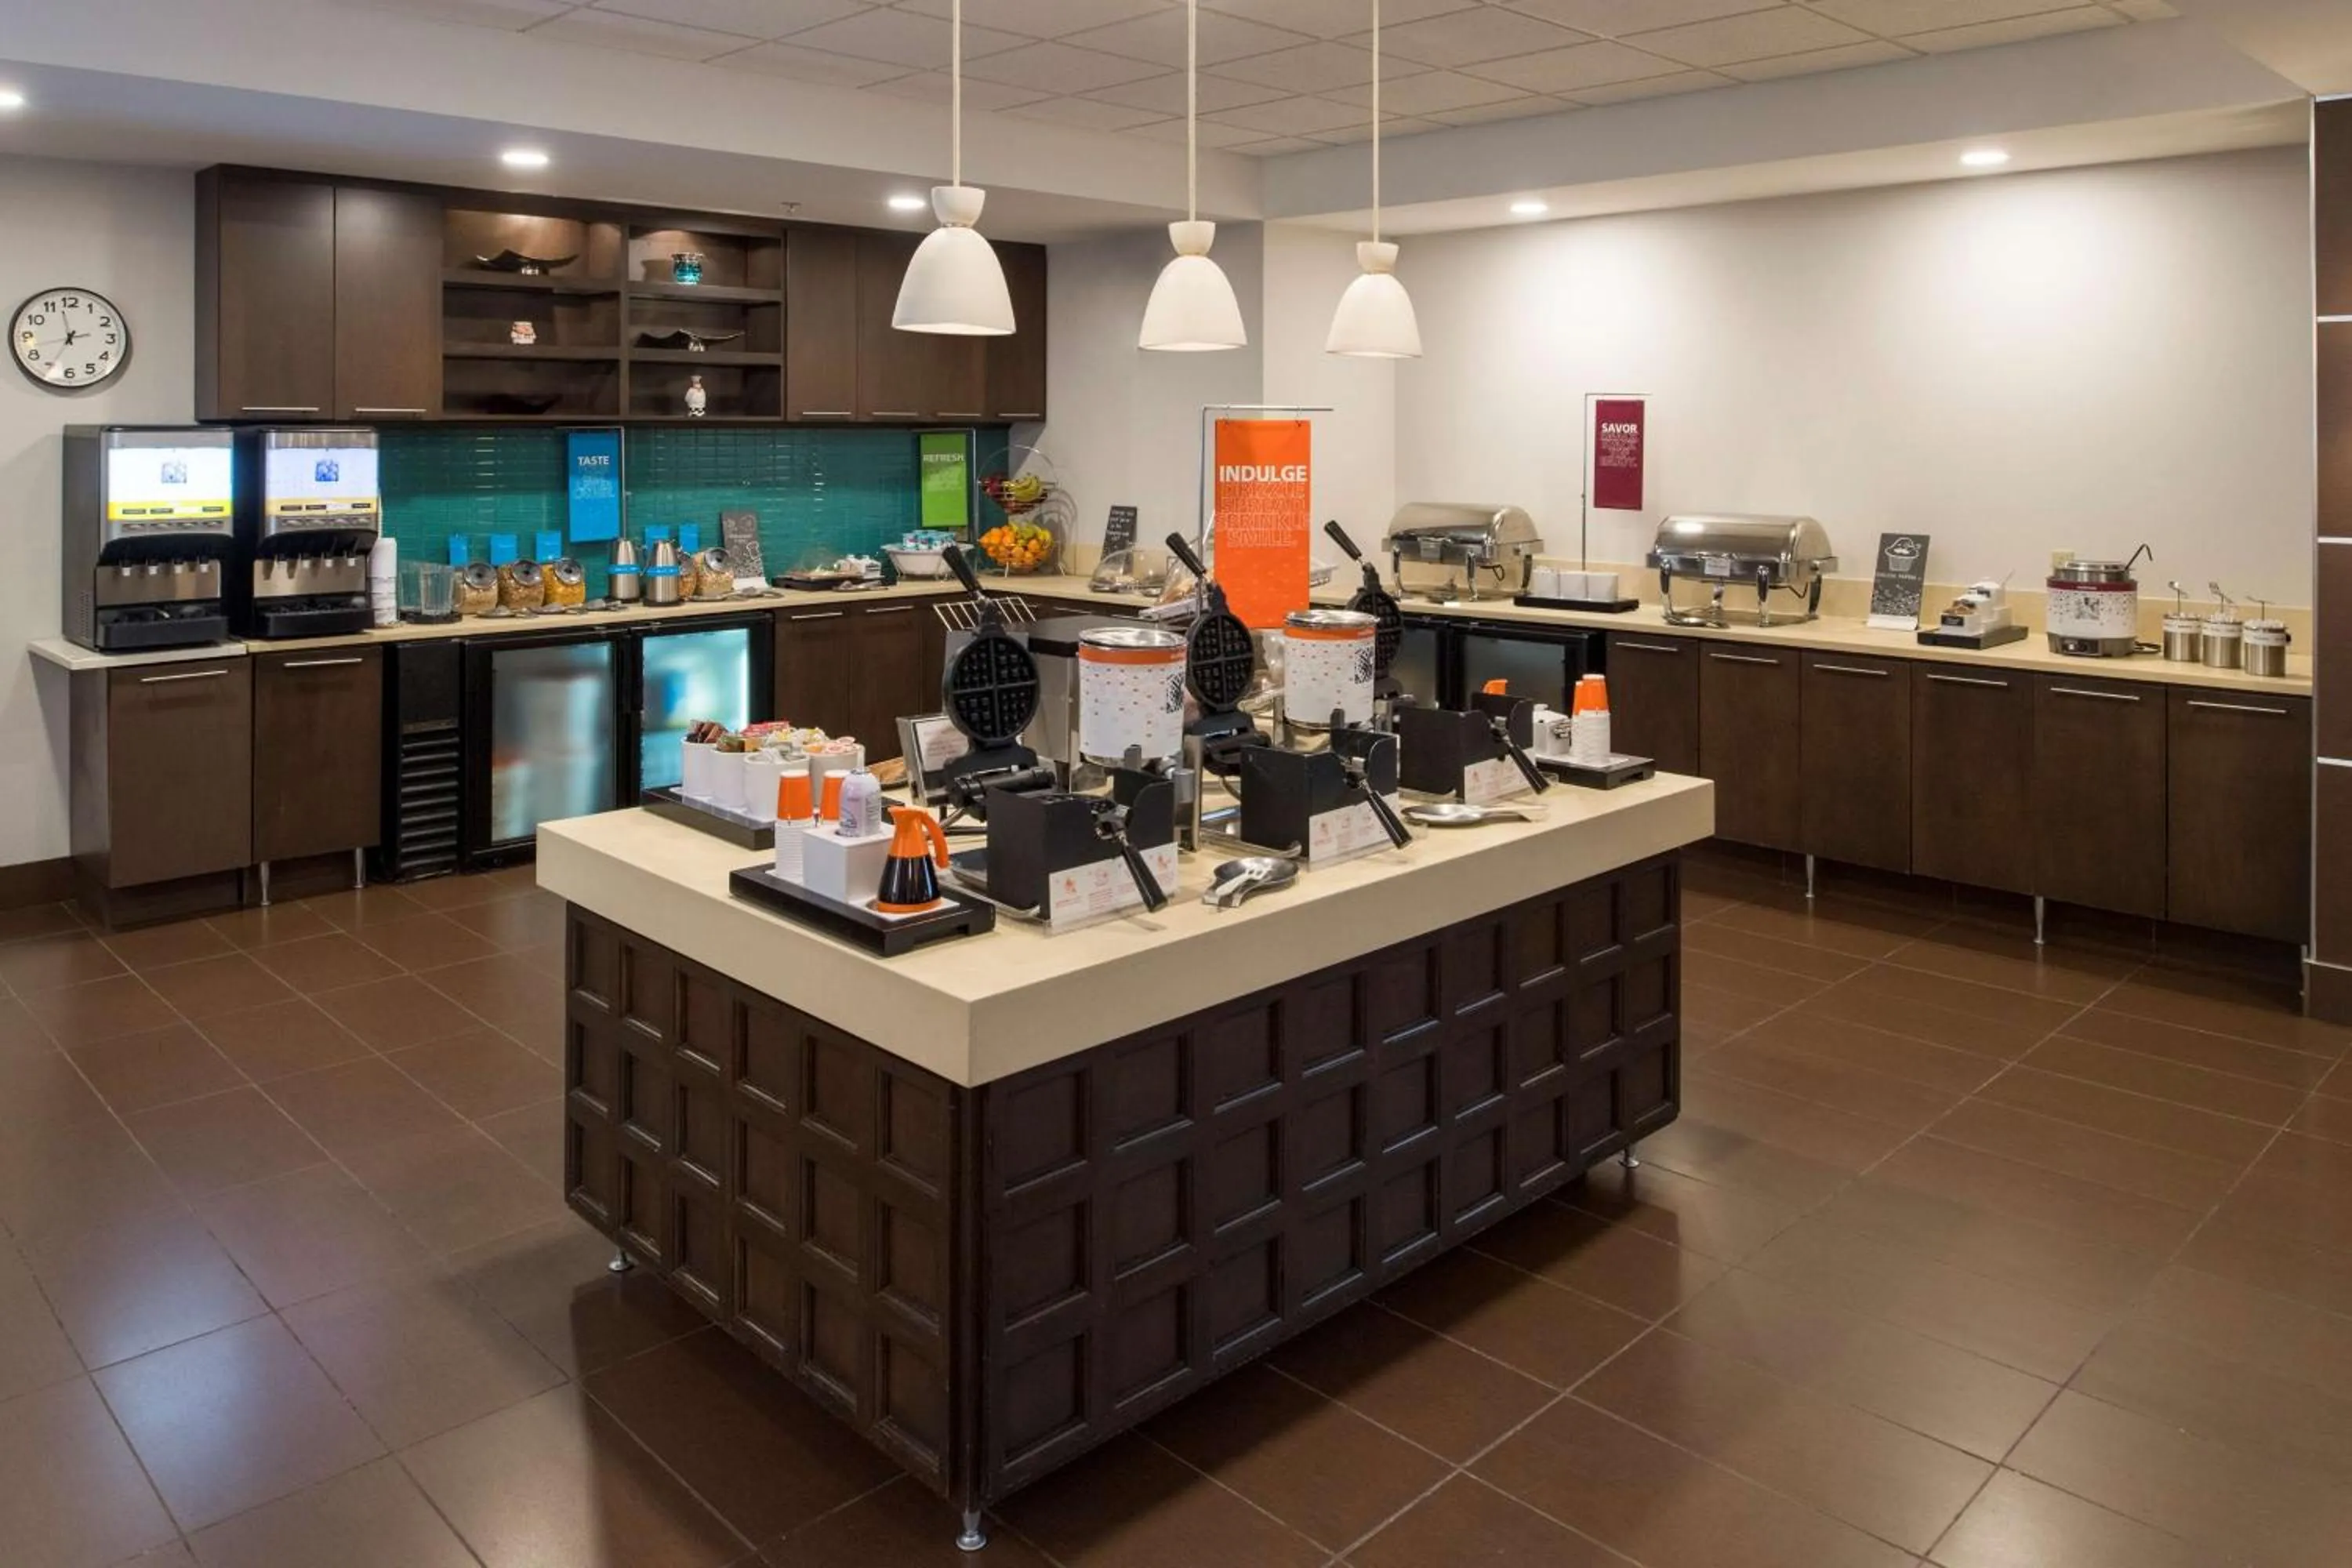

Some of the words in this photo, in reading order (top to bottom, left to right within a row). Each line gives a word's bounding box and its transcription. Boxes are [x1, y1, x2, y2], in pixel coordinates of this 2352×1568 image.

[43, 301, 56, 313] 11
[61, 297, 79, 308] 12
[87, 303, 93, 314] 1
[27, 314, 45, 325] 10
[100, 316, 111, 327] 2
[22, 331, 34, 343] 9
[105, 333, 116, 344] 3
[27, 349, 40, 361] 8
[99, 350, 109, 361] 4
[64, 368, 76, 379] 6
[85, 363, 96, 375] 5
[1602, 423, 1638, 434] SAVOR
[577, 456, 610, 466] TASTE
[923, 454, 964, 463] REFRESH
[1219, 465, 1307, 482] INDULGE
